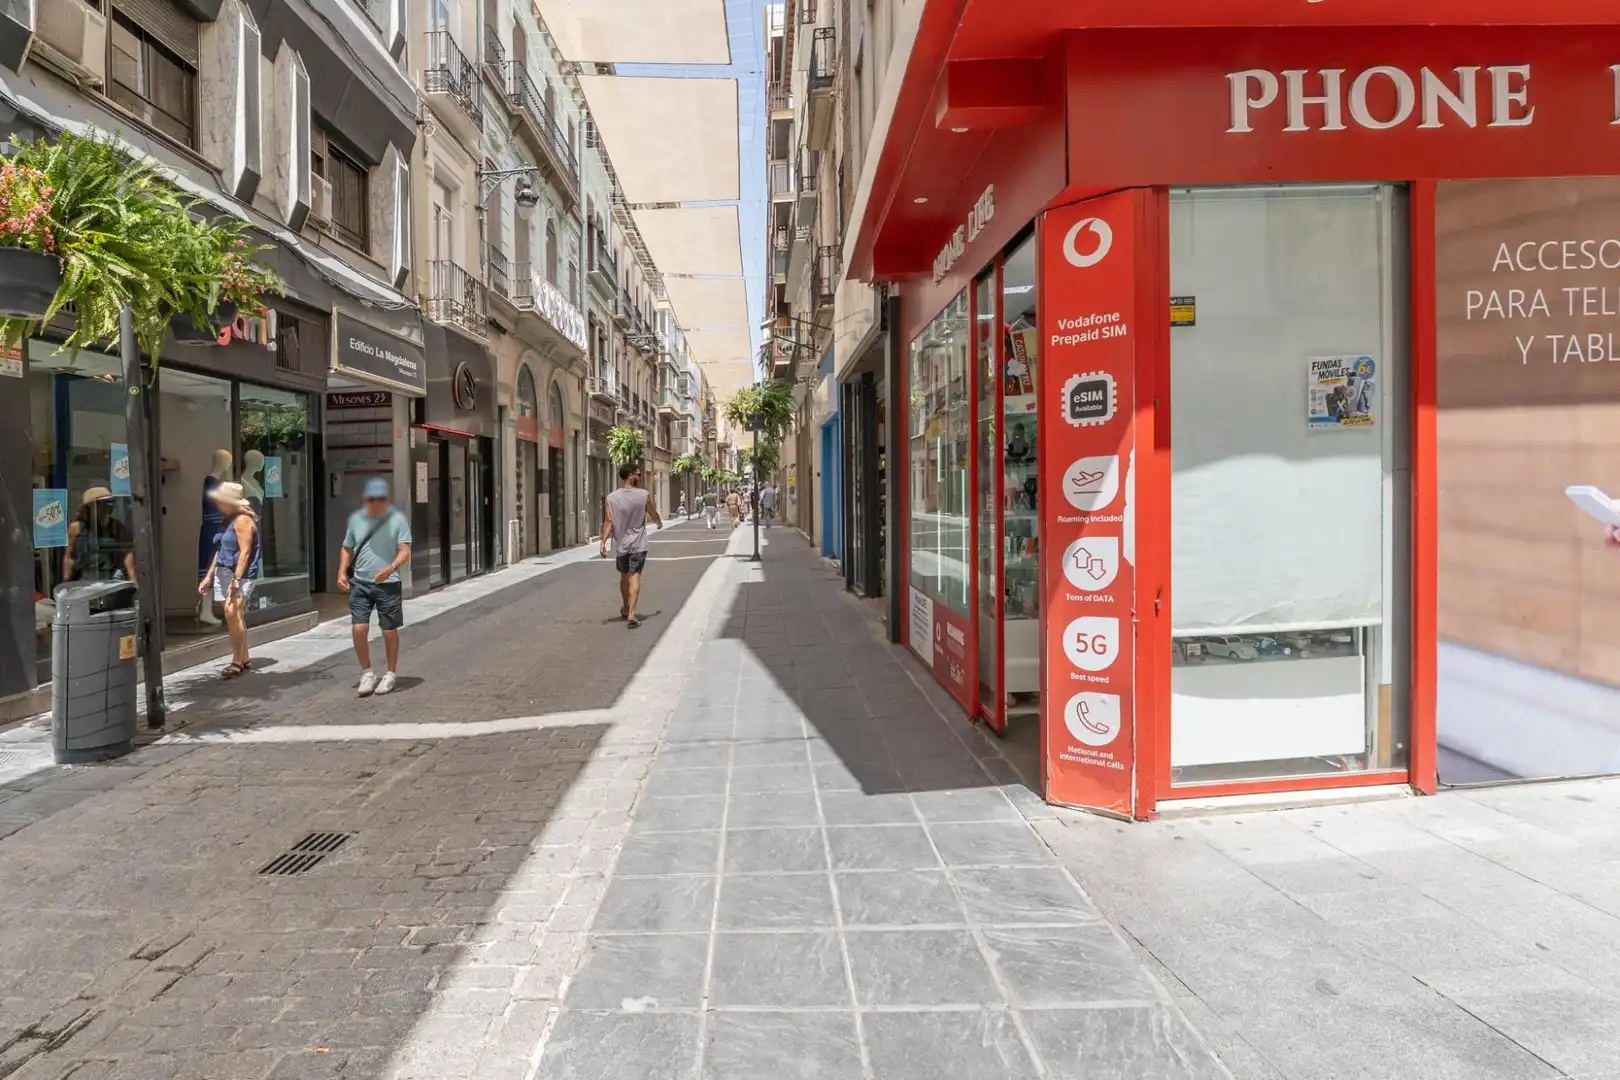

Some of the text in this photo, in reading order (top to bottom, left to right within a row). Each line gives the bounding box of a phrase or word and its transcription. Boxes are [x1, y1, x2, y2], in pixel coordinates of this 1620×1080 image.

[1225, 64, 1536, 133] PHONE
[932, 224, 965, 285] PHONE
[1492, 239, 1620, 272] ACCESO
[1466, 286, 1620, 320] PARA TEL
[1057, 312, 1121, 330] Vodafone
[1051, 324, 1128, 346] Prepaid SIM
[350, 337, 417, 370] Edificio La Magdalena
[1515, 335, 1535, 365] Y
[1312, 360, 1342, 372] FUNDAS
[372, 392, 386, 403] 23
[1073, 390, 1103, 403] eSIM
[1074, 403, 1103, 413] Available
[1057, 514, 1124, 525] Roaming Included
[1065, 593, 1115, 603] Tons of DATA
[1076, 632, 1107, 655] 5G
[1070, 672, 1110, 684] Best speed
[1067, 745, 1114, 760] National and
[1106, 760, 1125, 770] calls
